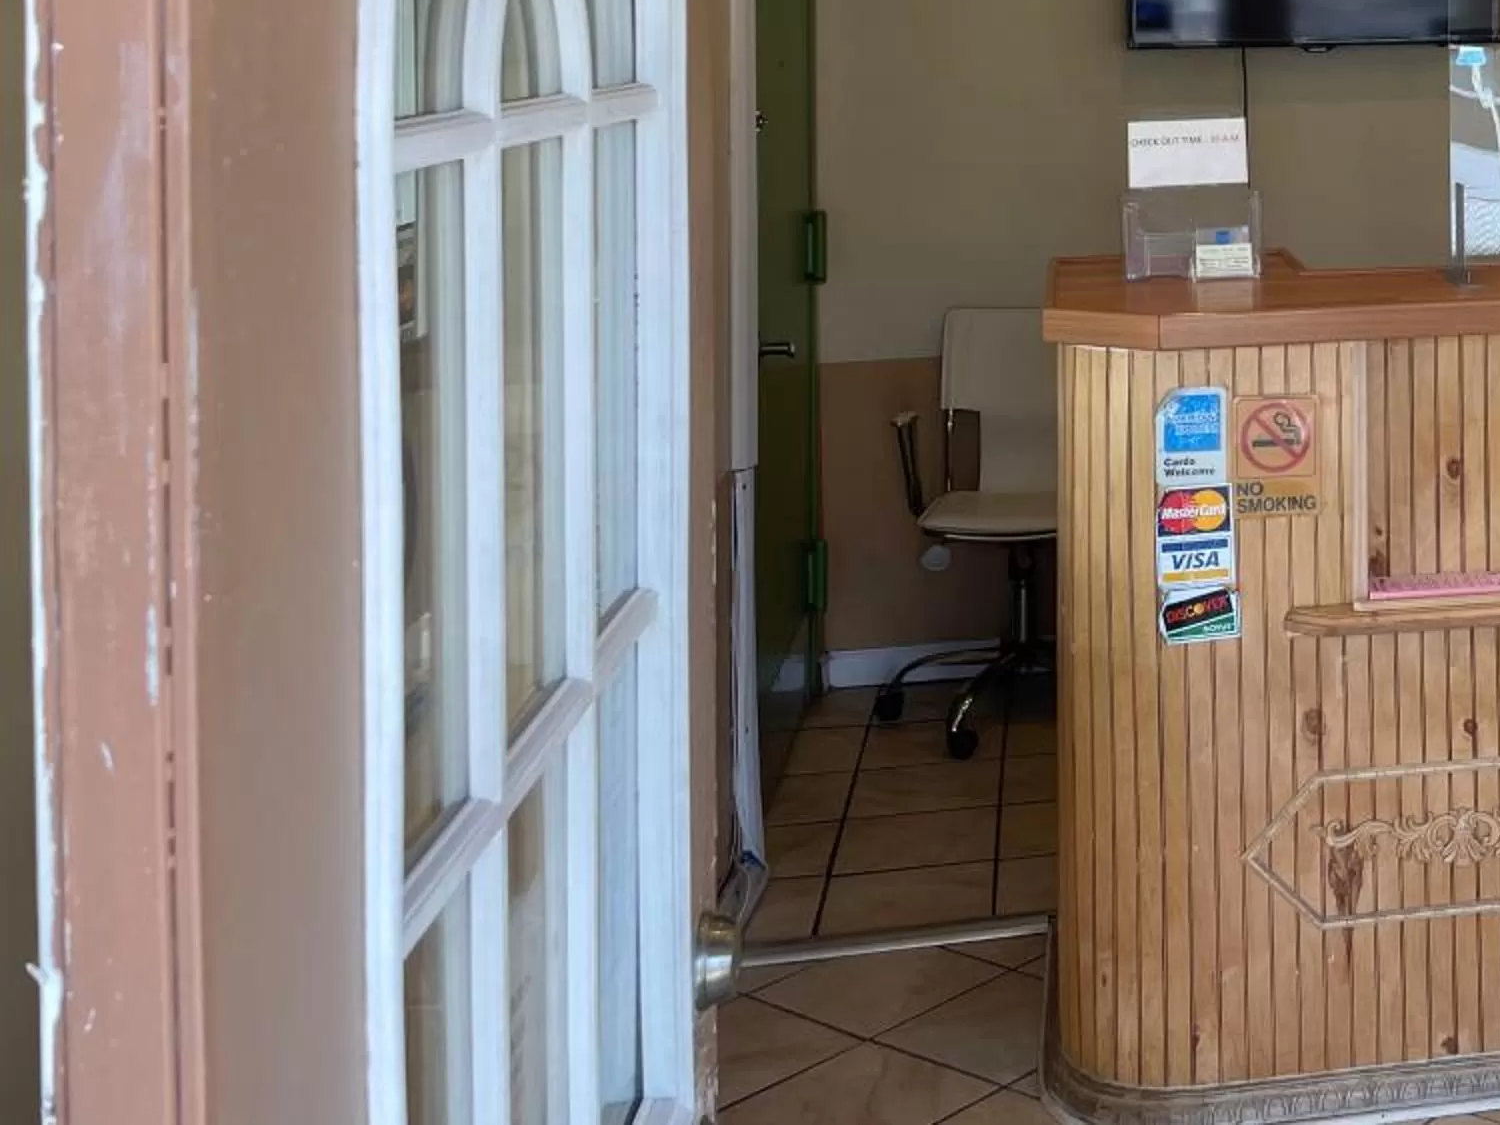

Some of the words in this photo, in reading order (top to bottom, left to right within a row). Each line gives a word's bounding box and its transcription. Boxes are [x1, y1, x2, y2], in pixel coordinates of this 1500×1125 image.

[1131, 138, 1160, 147] CHECK
[1160, 136, 1179, 145] OUT
[1163, 458, 1197, 467] Cards
[1163, 467, 1216, 478] Welcome
[1236, 482, 1264, 496] NO
[1160, 503, 1227, 520] MasterCard
[1235, 496, 1317, 514] SMOKING
[1171, 550, 1221, 570] VISA
[1166, 595, 1228, 624] DISCOVER
